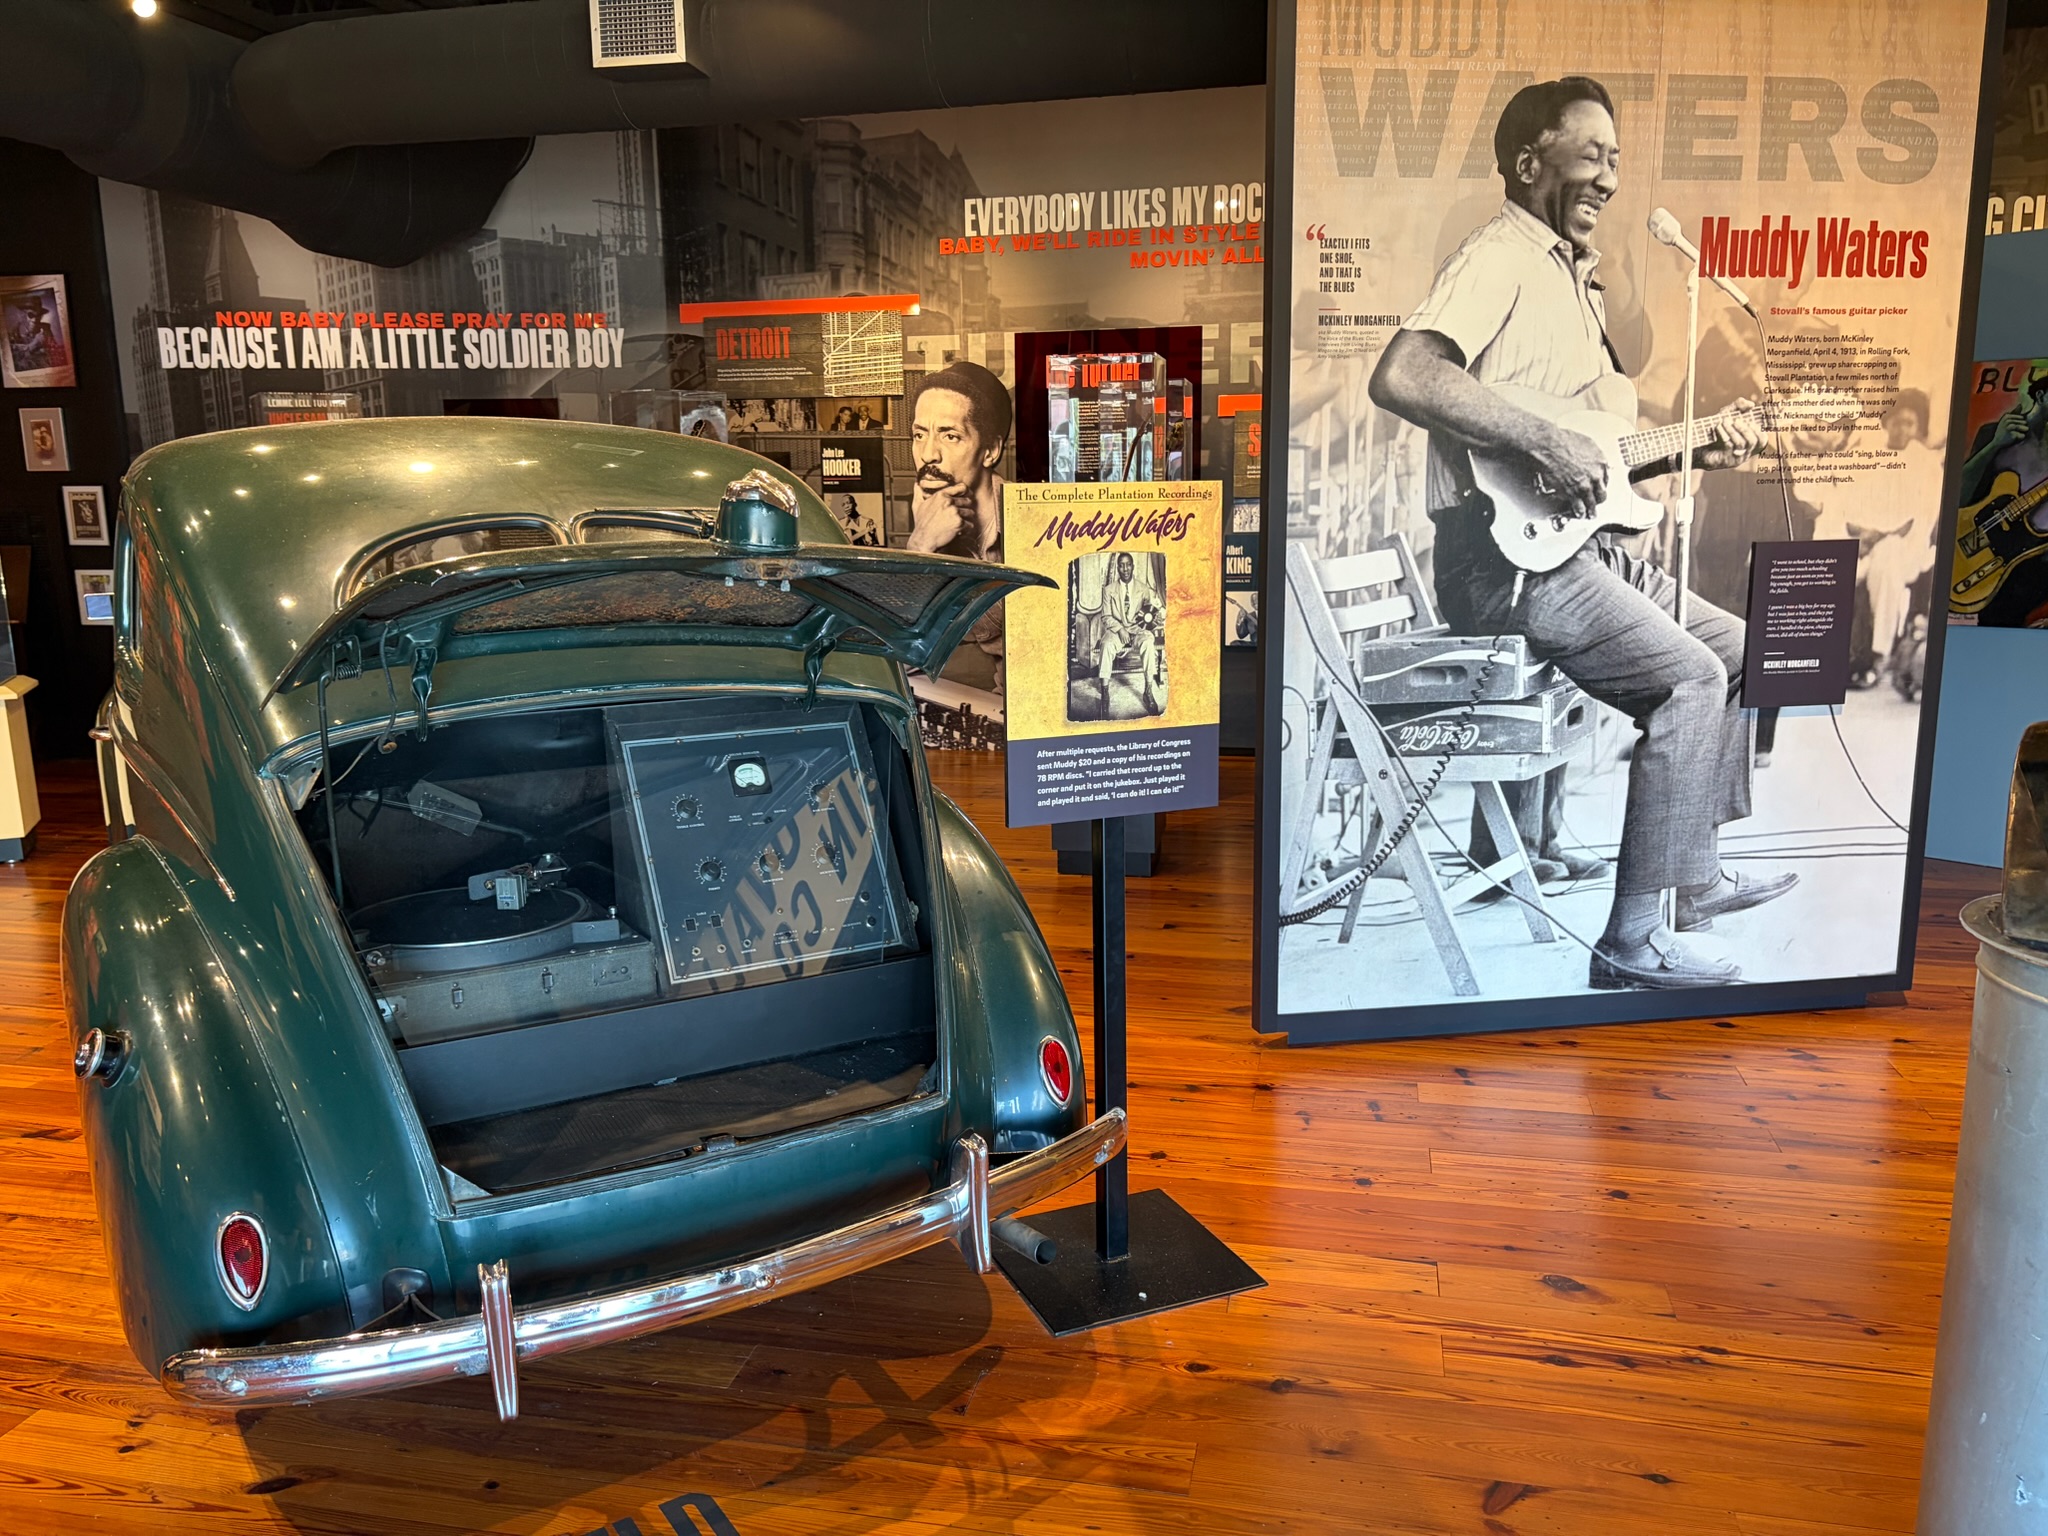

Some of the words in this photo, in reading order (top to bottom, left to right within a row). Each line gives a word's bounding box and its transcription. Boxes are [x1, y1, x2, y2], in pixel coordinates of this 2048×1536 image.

[1468, 61, 1508, 72] READY
[964, 191, 1095, 237] EVERYBODY
[1100, 187, 1166, 230] LIKES
[1172, 185, 1208, 226] MY
[1214, 182, 1266, 224] ROC
[2012, 194, 2048, 233] CI
[939, 236, 1004, 256] BABY,
[1012, 232, 1080, 251] WE'LL
[1088, 228, 1142, 247] RIDE
[1150, 227, 1174, 244] IN
[1183, 222, 1261, 244] STYLE
[1320, 238, 1349, 250] EXACTLY
[1355, 238, 1370, 250] FITS
[1130, 248, 1216, 268] MOVIN'
[1222, 246, 1265, 264] ALL
[1320, 252, 1333, 264] ONE
[1335, 252, 1355, 266] SHOE,
[1698, 214, 1810, 290] Muddy
[1816, 217, 1929, 278] Waters
[1320, 267, 1334, 278] AND
[1336, 267, 1352, 278] THAT
[1354, 267, 1362, 278] IS
[1320, 282, 1332, 292] THE
[1334, 282, 1355, 292] BLUES
[1770, 306, 1810, 315] Stovall's
[1812, 306, 1847, 315] famous
[1849, 307, 1877, 316] guitar
[1879, 306, 1908, 316] picker
[215, 311, 272, 328] NOW
[280, 312, 346, 328] BABY
[354, 312, 445, 329] PLEASE
[452, 312, 513, 329] PRAY
[520, 312, 566, 329] FOR
[574, 312, 608, 329] ME
[1318, 315, 1352, 326] MCKINLEY
[1354, 315, 1401, 326] MORGANFIELD
[716, 326, 792, 361] DETROIT
[1768, 335, 1793, 344] Muddy
[1841, 334, 1874, 344] McKinley
[157, 327, 281, 370] BECAUSE
[284, 328, 296, 370] I
[302, 328, 344, 370] AM
[350, 328, 370, 370] A
[372, 328, 460, 370] LITTLE
[463, 328, 570, 370] SOLDIER
[574, 328, 624, 370] BOY
[1767, 348, 1812, 357] Morganfield,
[1813, 348, 1830, 357] April
[1868, 347, 1892, 357] Rolling
[1893, 347, 1910, 356] Fork,
[1766, 361, 1807, 371] Mississippi,
[1838, 360, 1887, 370] sharecropping
[1764, 373, 1789, 384] Stovall
[835, 448, 845, 458] Lee
[822, 459, 861, 476] HOOKER
[1016, 488, 1038, 501] The
[1042, 488, 1094, 502] Complete
[1098, 488, 1154, 500] Plantation
[1158, 486, 1213, 500] Recordings
[1033, 510, 1124, 551] Muddy
[1120, 507, 1195, 546] Waters
[1226, 556, 1252, 574] KING
[1056, 747, 1084, 756] multiple
[1085, 746, 1116, 755] requests,
[1161, 739, 1191, 748] Congress
[1053, 760, 1077, 769] Muddy
[1078, 758, 1092, 767] $20
[1093, 757, 1106, 765] and
[1147, 751, 1181, 760] recordings
[1048, 773, 1064, 781] RPM
[1093, 768, 1116, 777] carried
[1131, 764, 1152, 773] record
[1060, 784, 1073, 792] and
[1074, 784, 1086, 792] put
[1114, 778, 1142, 788] jukebox.
[1158, 774, 1179, 784] played
[1038, 798, 1050, 806] and
[1052, 796, 1074, 807] played
[1081, 794, 1094, 802] and
[1095, 792, 1110, 800] said,
